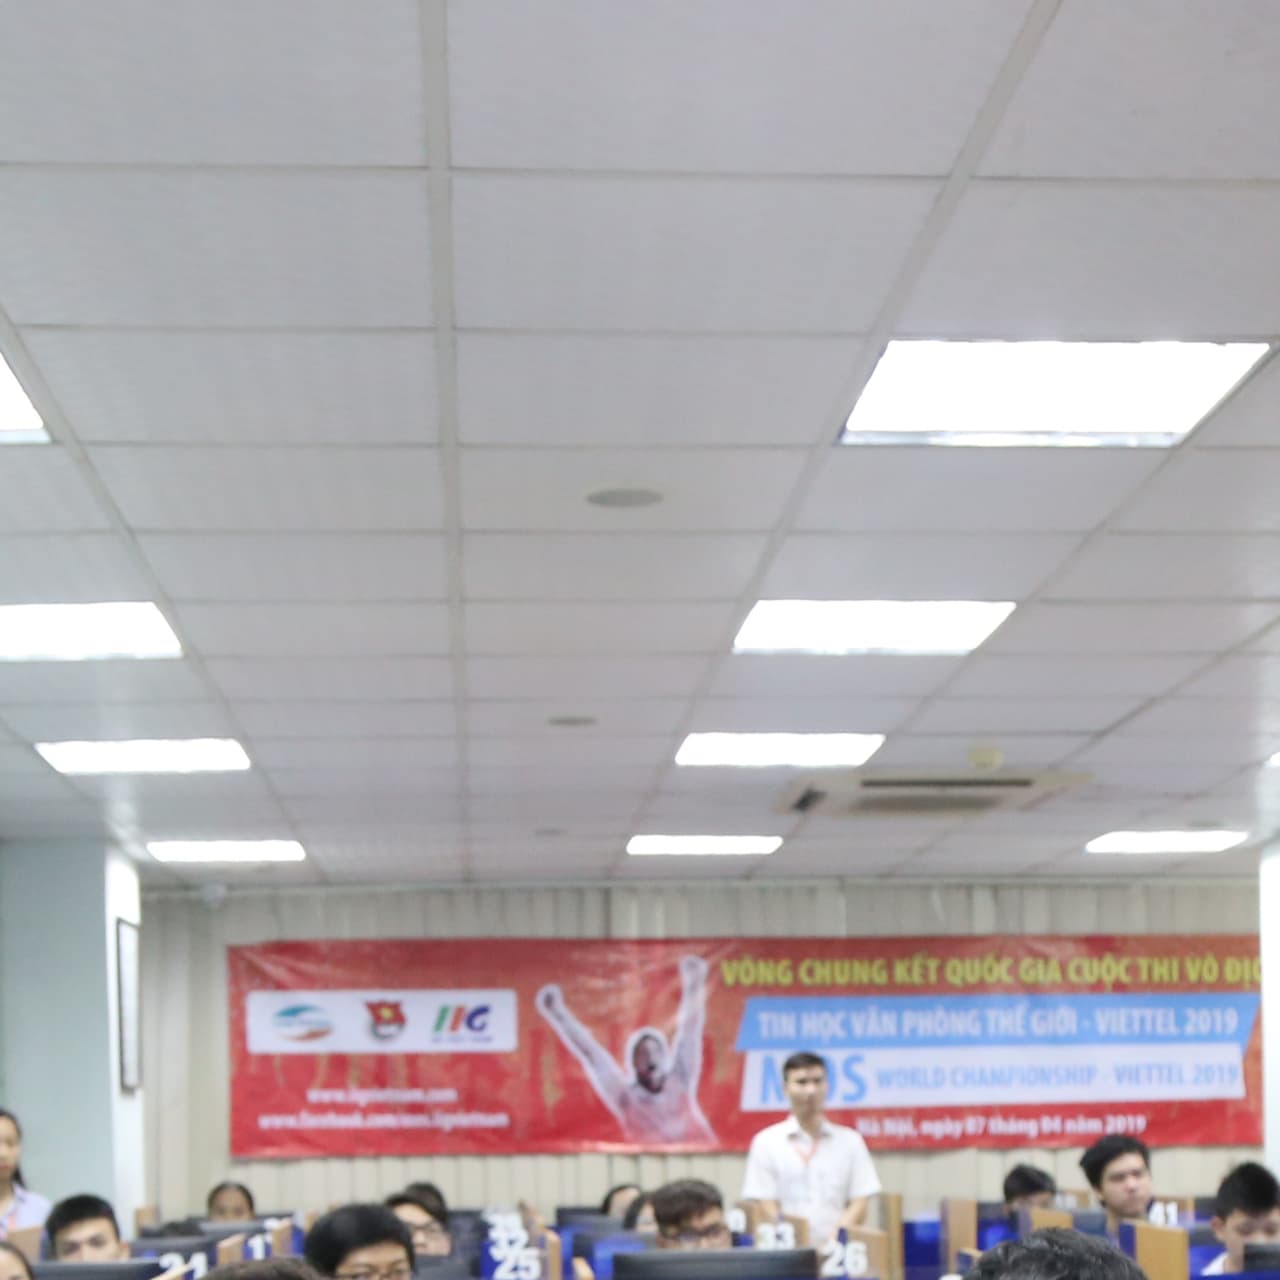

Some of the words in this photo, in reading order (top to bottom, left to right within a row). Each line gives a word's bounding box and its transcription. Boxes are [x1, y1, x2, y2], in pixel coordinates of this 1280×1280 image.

[798, 958, 889, 987] CHUNG
[893, 951, 941, 986] KẾT
[1018, 957, 1063, 984] GIA
[1137, 957, 1181, 983] THI
[758, 1011, 797, 1038] TIN
[1094, 1008, 1180, 1036] VIETTEL
[1183, 1007, 1239, 1035] 2019
[875, 1066, 946, 1089] WORLD
[950, 1063, 1096, 1089] CHAMPIONSHIP
[1113, 1061, 1185, 1085] VIETTEL
[1193, 1061, 1239, 1085] 2019
[821, 1240, 868, 1277] 26
